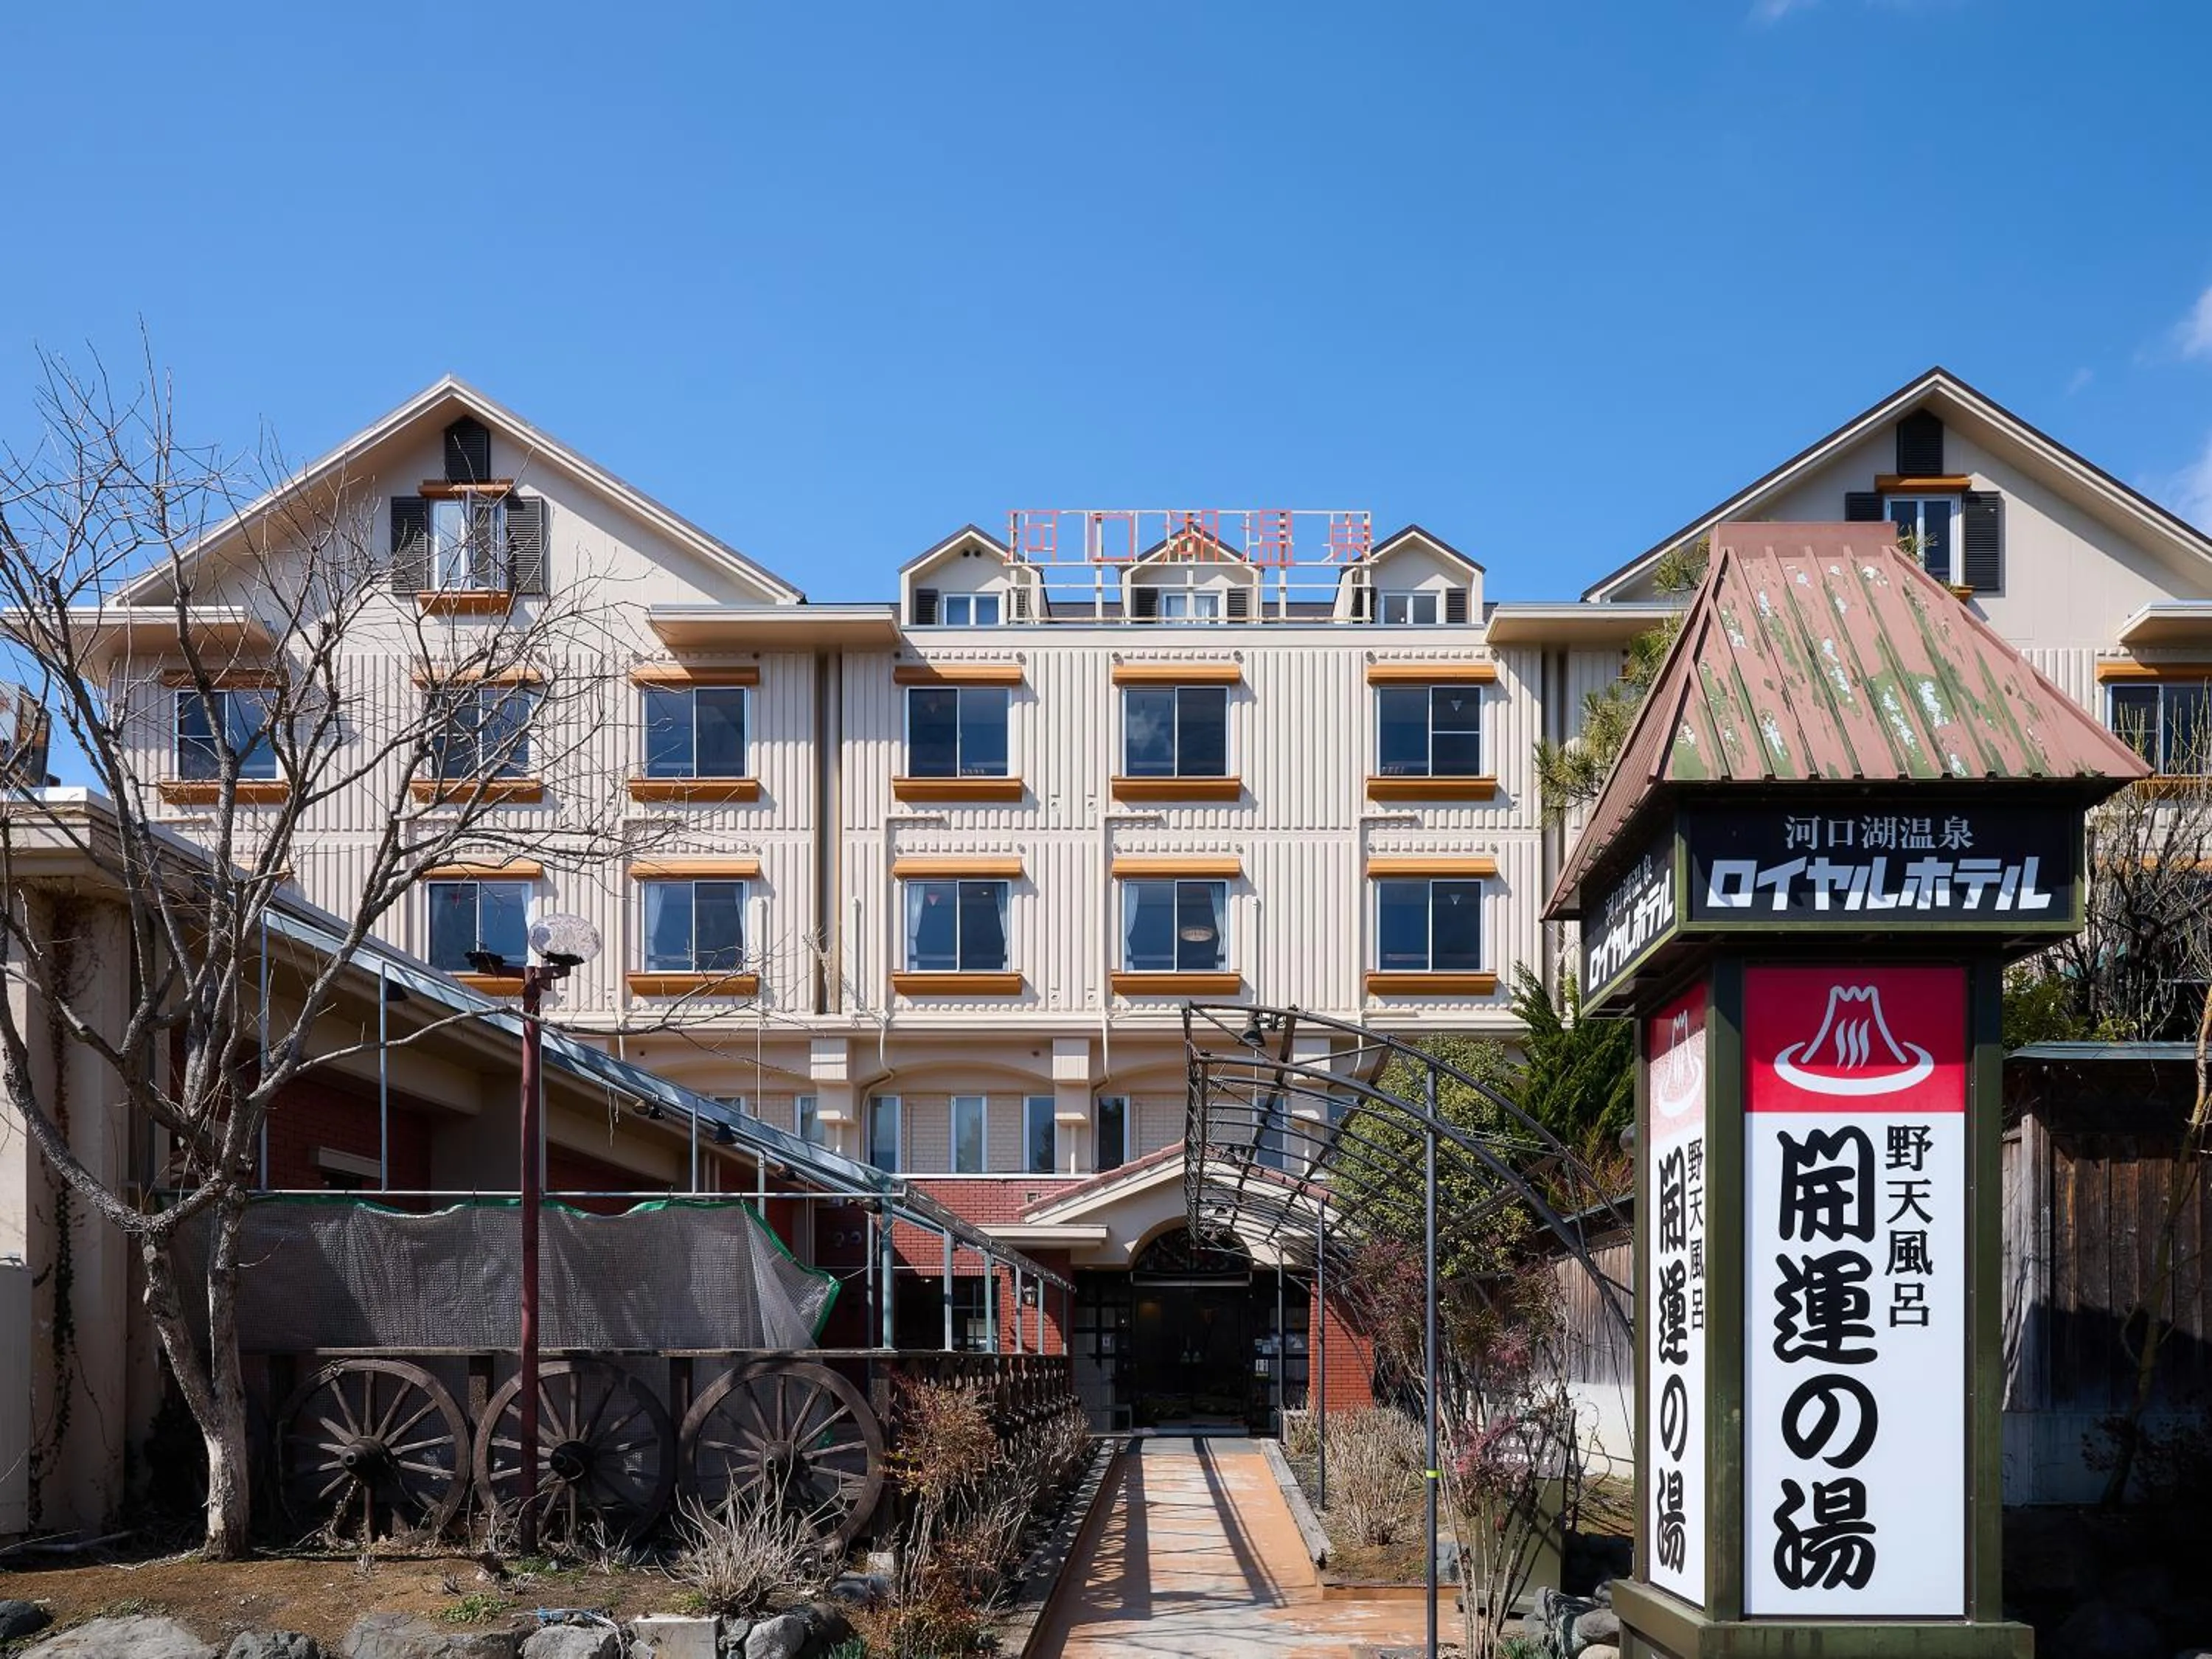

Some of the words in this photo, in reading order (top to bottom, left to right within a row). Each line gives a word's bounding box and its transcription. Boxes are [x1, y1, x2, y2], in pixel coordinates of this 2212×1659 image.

[1588, 868, 1674, 992] ロイヤルホテル
[1706, 855, 2055, 911] ロイヤルホテル
[1784, 815, 1975, 849] 河口湖温泉
[1688, 1136, 1705, 1332] 野天風呂
[1885, 1124, 1933, 1329] 野天風呂
[1658, 1144, 1688, 1575] 開運の湯
[1773, 1124, 1879, 1591] 開運の湯
